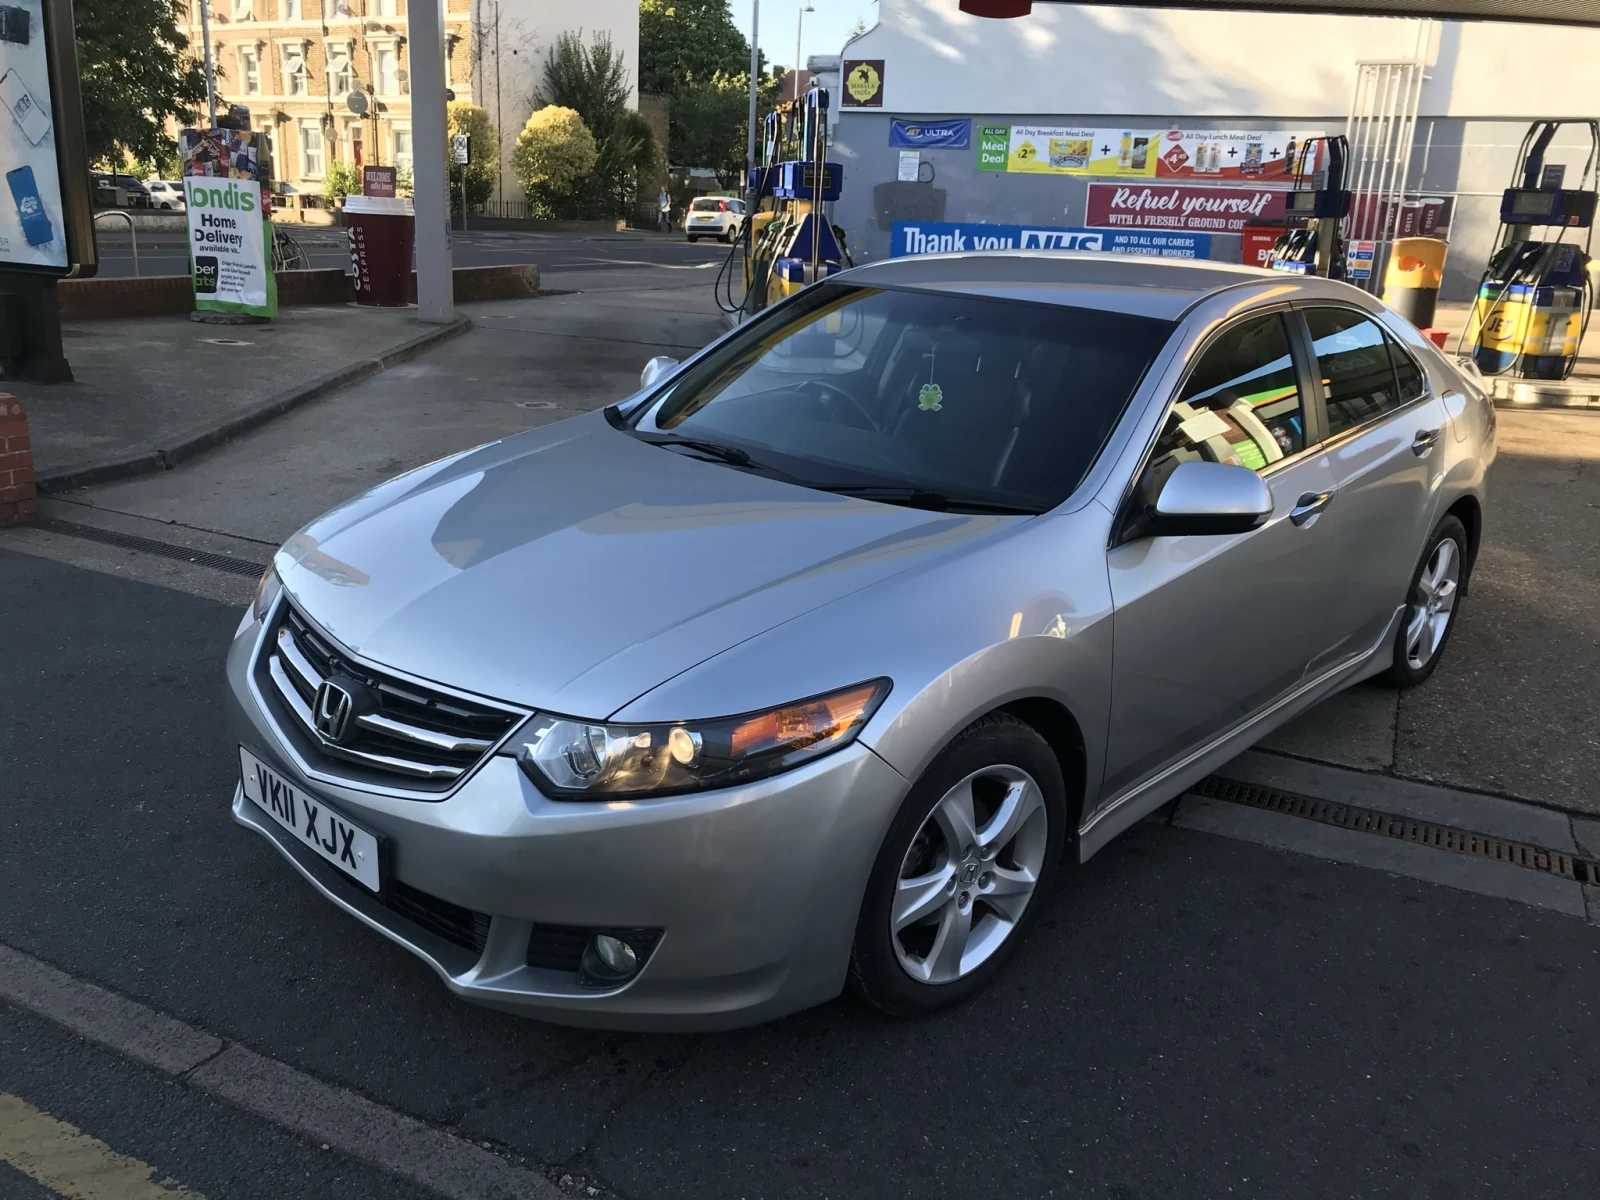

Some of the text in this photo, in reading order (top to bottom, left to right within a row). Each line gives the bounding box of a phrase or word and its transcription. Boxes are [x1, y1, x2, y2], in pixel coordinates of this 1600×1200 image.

[925, 129, 954, 137] ULTRA
[982, 141, 1006, 151] Meal
[982, 154, 1004, 163] Deal
[365, 171, 391, 182] WELCOME
[1111, 187, 1272, 217] Refuel yourself
[201, 213, 236, 229] Home
[1109, 214, 1246, 229] WITH A FRESHLY GROUND COF
[1404, 212, 1414, 233] COSTA
[1425, 209, 1435, 228] COSTA
[195, 229, 243, 248] Delivery
[904, 227, 1100, 254] Thank you NHS
[1114, 235, 1194, 247] AND TO ALL OUR CARERS
[200, 245, 229, 253] available
[357, 226, 370, 282] EXPRESS
[1127, 246, 1160, 255] ESSENTIAL
[1162, 249, 1195, 258] WORKERS
[348, 226, 361, 291] COSTA
[196, 276, 215, 286] ats
[1487, 317, 1514, 332] JET
[256, 763, 357, 870] VK11 XJX
